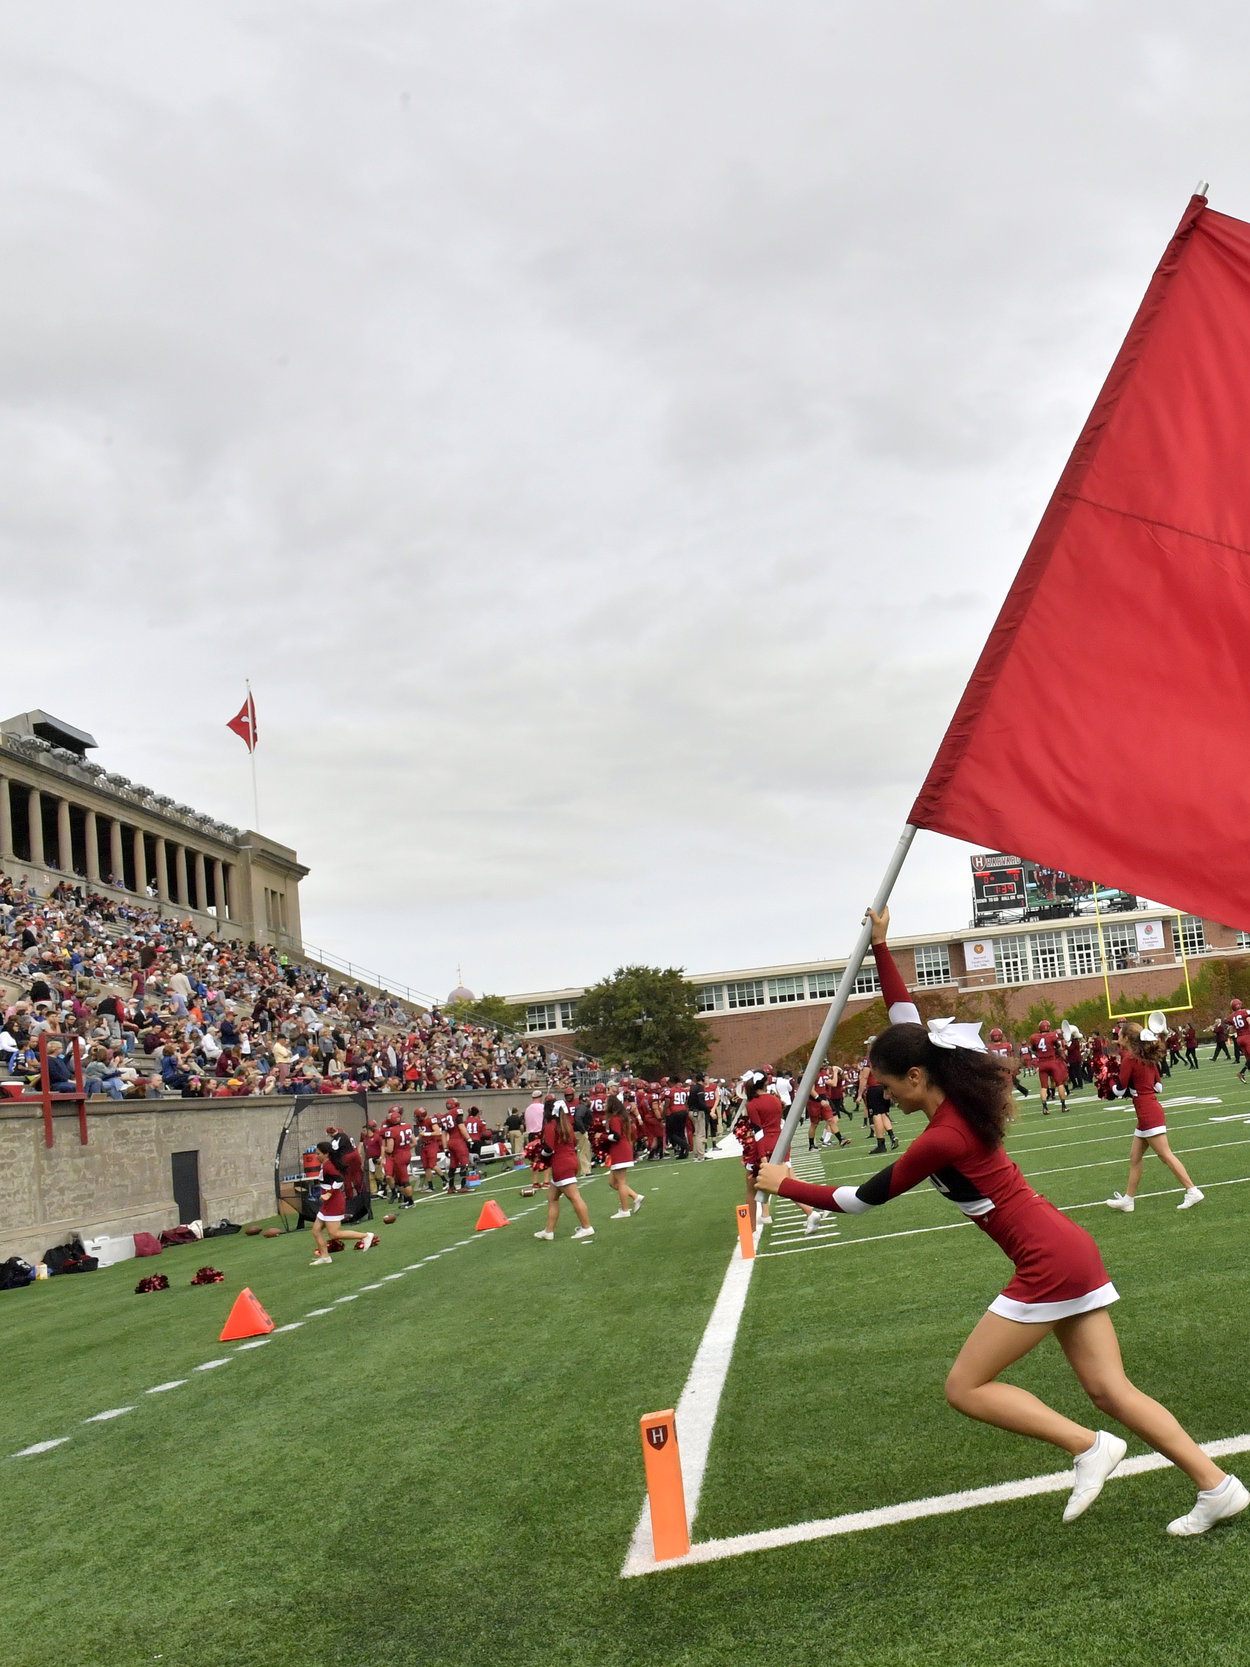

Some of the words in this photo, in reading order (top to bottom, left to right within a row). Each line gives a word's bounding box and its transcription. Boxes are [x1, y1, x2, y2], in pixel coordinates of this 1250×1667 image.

[975, 857, 984, 867] H
[986, 856, 1021, 867] HARVARD
[995, 884, 1014, 894] 1:39
[1232, 1014, 1245, 1029] 16
[1038, 1038, 1048, 1052] 4
[673, 1091, 687, 1105] 90
[704, 1091, 715, 1101] 25
[590, 1099, 603, 1112] 76
[441, 1114, 455, 1131] 53
[466, 1122, 478, 1134] 41
[399, 1128, 413, 1146] 13
[651, 1427, 665, 1445] H
